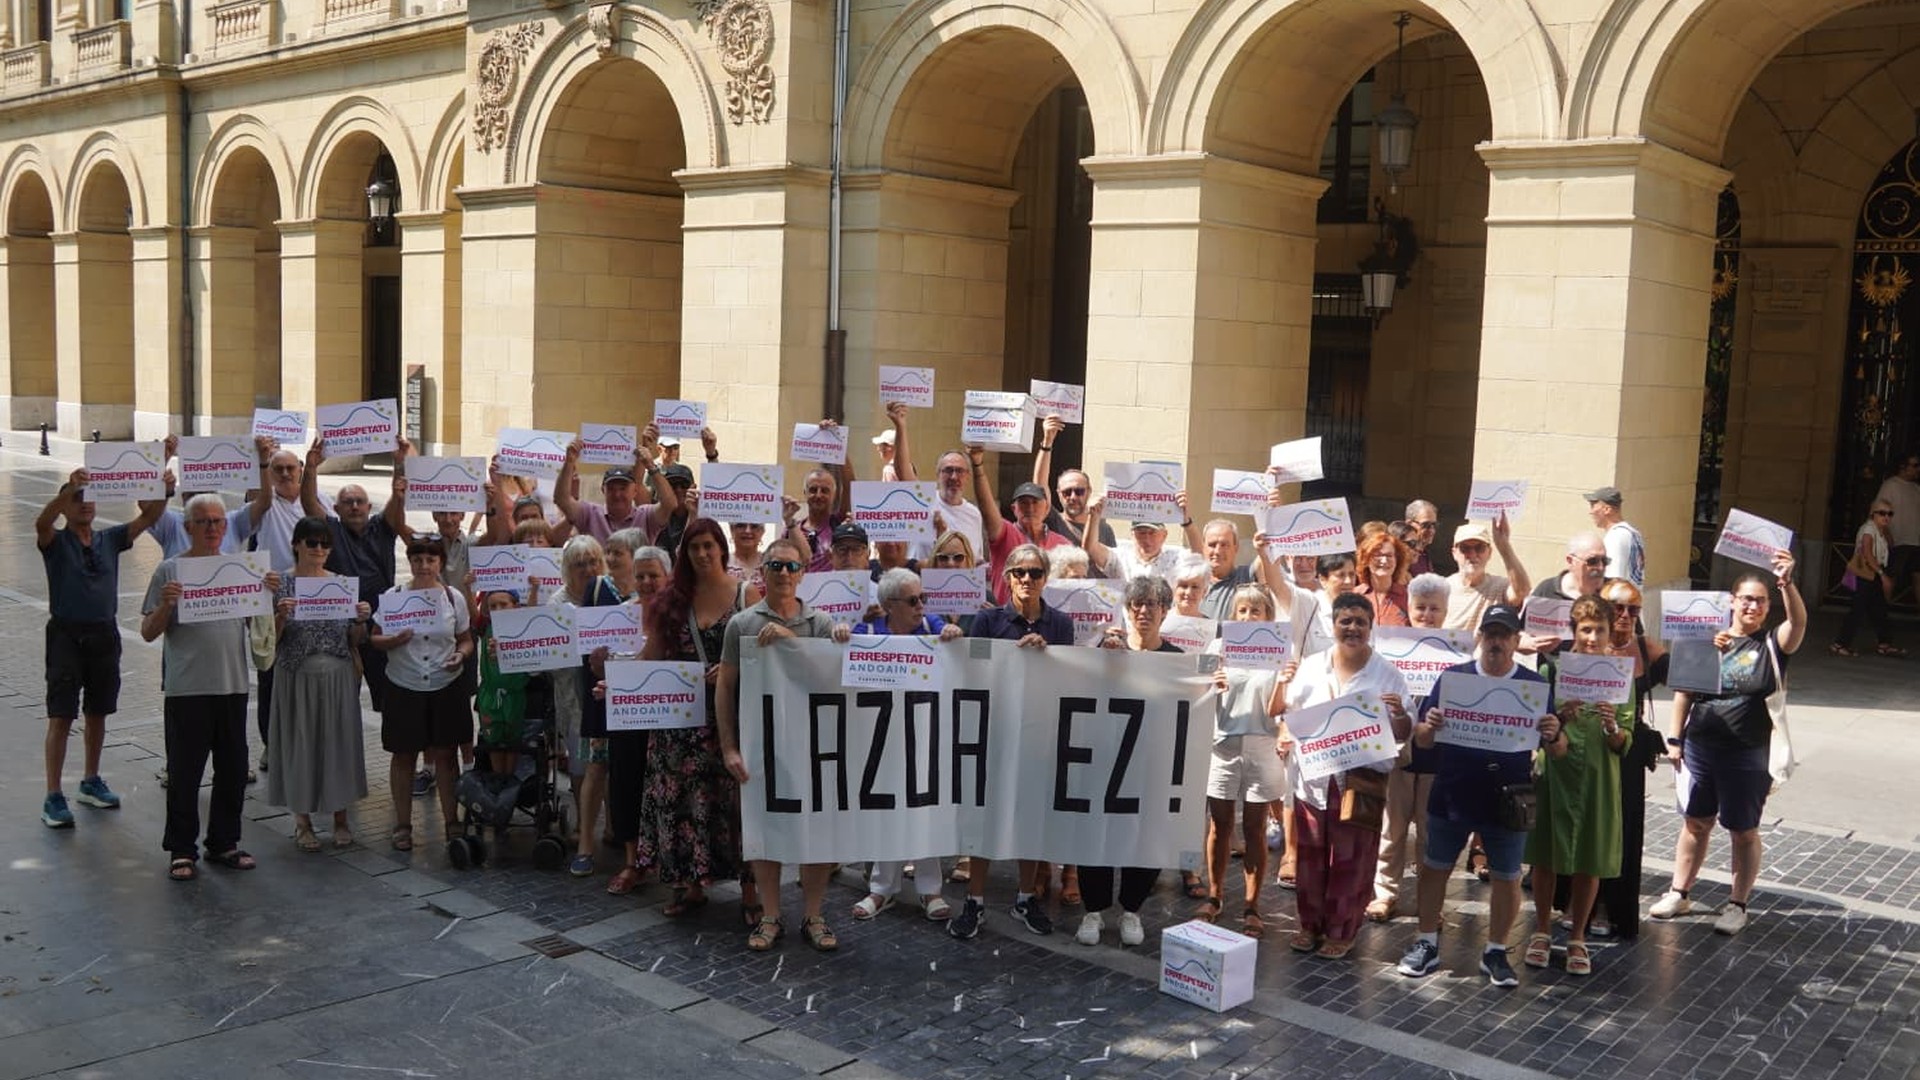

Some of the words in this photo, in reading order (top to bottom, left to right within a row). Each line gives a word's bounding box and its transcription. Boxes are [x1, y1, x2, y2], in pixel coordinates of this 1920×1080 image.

[323, 424, 391, 438] ERRESPETATU
[325, 436, 371, 447] ANDOAIN
[501, 448, 566, 462] ERRESPETATU
[183, 462, 250, 472] ERRESPETATU
[500, 458, 545, 468] ANDOAIN
[89, 472, 158, 480] ERRESPETATU
[90, 482, 137, 490] ANDOAIN
[409, 484, 478, 492] ERRESPETATU
[704, 492, 774, 503] ERRESPETATU
[1107, 490, 1177, 502] ERRESPETATU
[704, 502, 752, 510] ANDOAIN
[1107, 502, 1154, 510] ANDOAIN
[856, 512, 929, 520] ERRESPETATU
[184, 583, 262, 600] ERRESPETATU
[184, 597, 239, 610] ANDOAIN
[384, 610, 436, 622] ERRESPETATU
[579, 628, 638, 638] ERRESPETATU
[500, 636, 570, 651] ERRESPETATU
[502, 650, 549, 660] ANDOAIN
[1225, 646, 1284, 654] ERRESPETATU
[849, 651, 934, 665] ERRESPETATU
[850, 664, 908, 674] ANDOAIN
[1406, 672, 1437, 682] OAIN
[1560, 674, 1626, 688] ERRESPETATU
[612, 694, 696, 705] ERRESPETATU
[612, 706, 670, 716] ANDOAIN
[1444, 708, 1534, 728] ERRESPETATU
[1444, 721, 1504, 737] ANDOAIN
[1300, 724, 1382, 754] ERRESPETATU
[762, 689, 990, 814] LAZOA
[1053, 697, 1145, 814] EZ
[1169, 700, 1190, 814] !
[1304, 744, 1360, 764] ANDOAIN
[1164, 968, 1214, 992] ERRESPETATU
